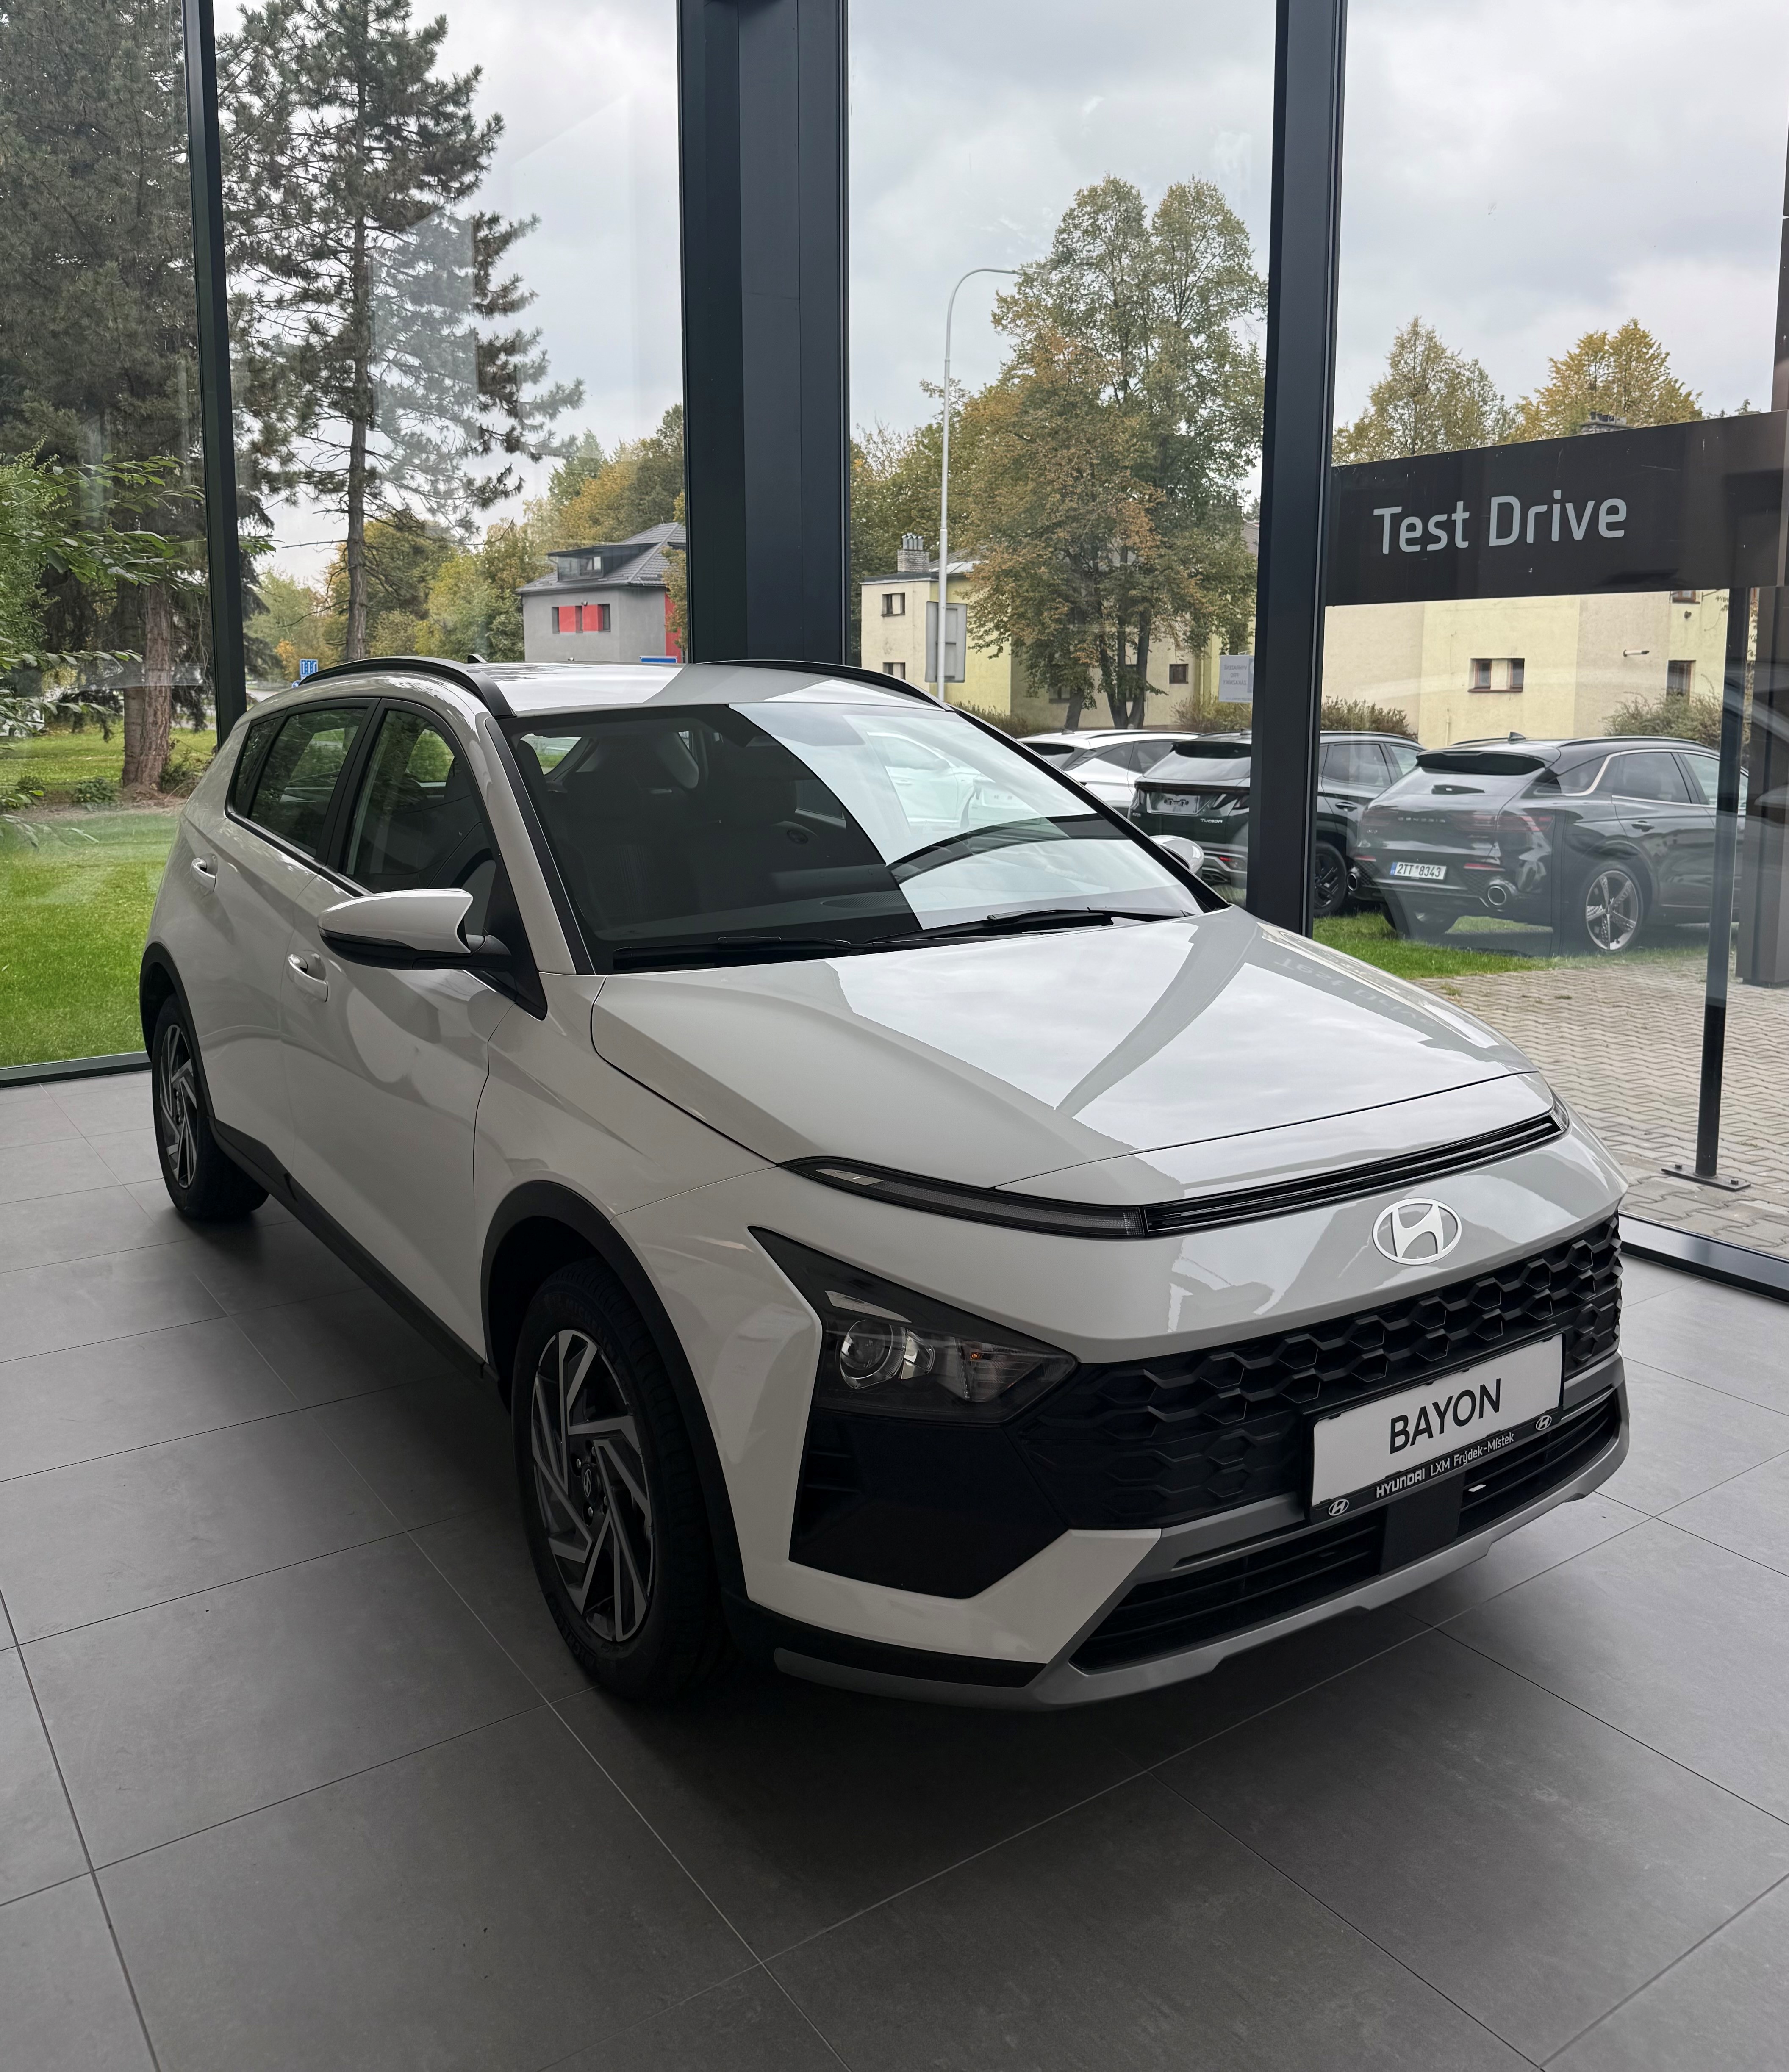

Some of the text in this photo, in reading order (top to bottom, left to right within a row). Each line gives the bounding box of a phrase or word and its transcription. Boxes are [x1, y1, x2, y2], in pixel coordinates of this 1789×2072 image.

[1373, 489, 1627, 554] Test Drive
[1397, 864, 1441, 878] 2TT 8343
[1390, 1378, 1501, 1454] BAYON
[1376, 1432, 1514, 1498] HYUNDAI LXM Frýdek-Místek
